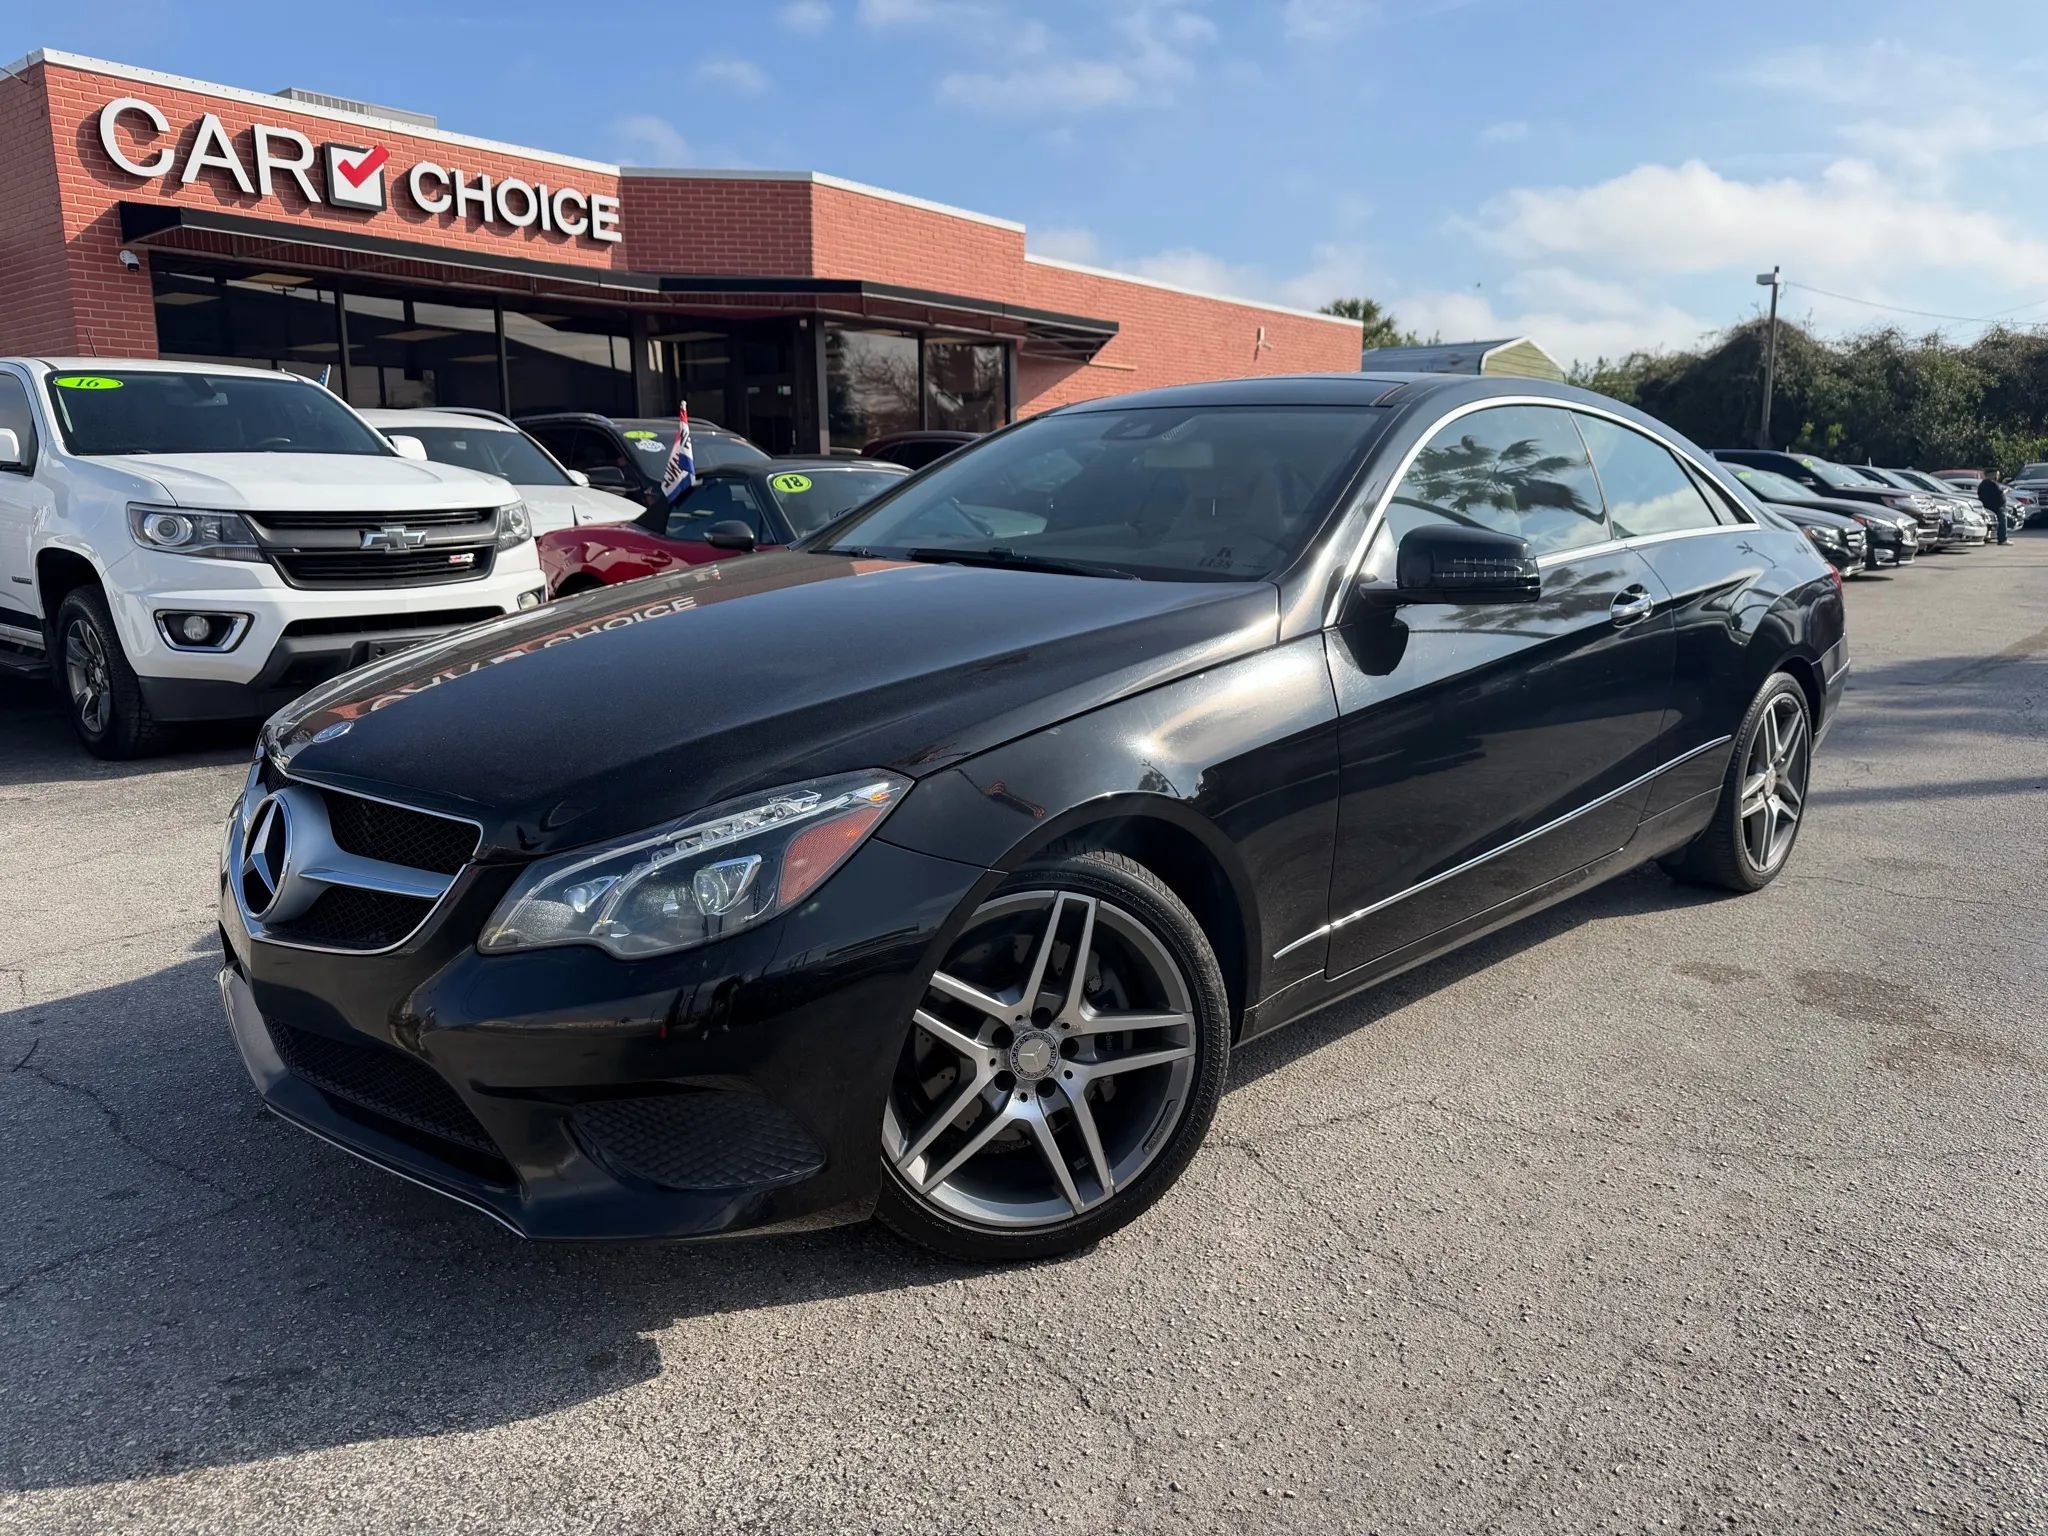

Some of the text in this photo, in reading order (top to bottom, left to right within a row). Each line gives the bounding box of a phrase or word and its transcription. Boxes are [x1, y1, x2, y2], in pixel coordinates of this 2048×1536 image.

[99, 97, 623, 243] CAR CHOICE
[75, 378, 100, 388] 16
[781, 476, 804, 489] 18
